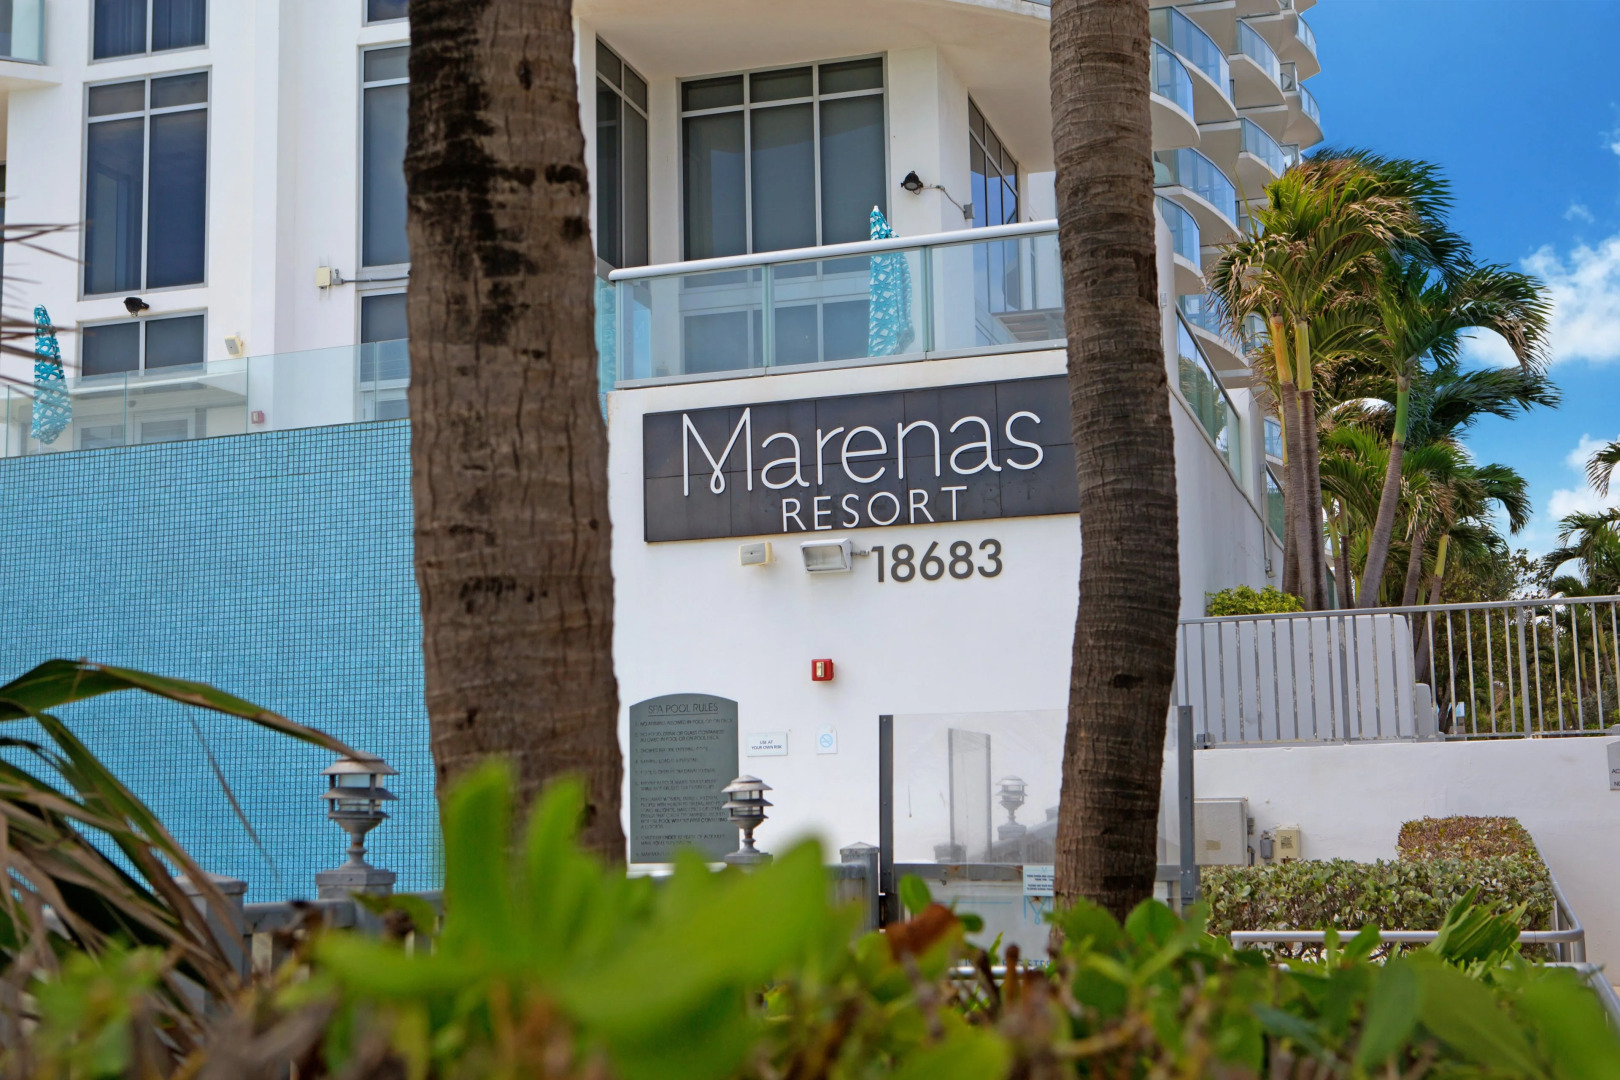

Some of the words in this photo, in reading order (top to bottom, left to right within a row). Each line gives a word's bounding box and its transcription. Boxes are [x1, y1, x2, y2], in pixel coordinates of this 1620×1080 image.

[683, 407, 1044, 496] Marenas
[782, 486, 968, 532] RESORT
[871, 538, 1002, 583] 18683
[648, 704, 663, 714] SPA
[665, 704, 690, 713] POOL
[693, 702, 719, 712] RULES
